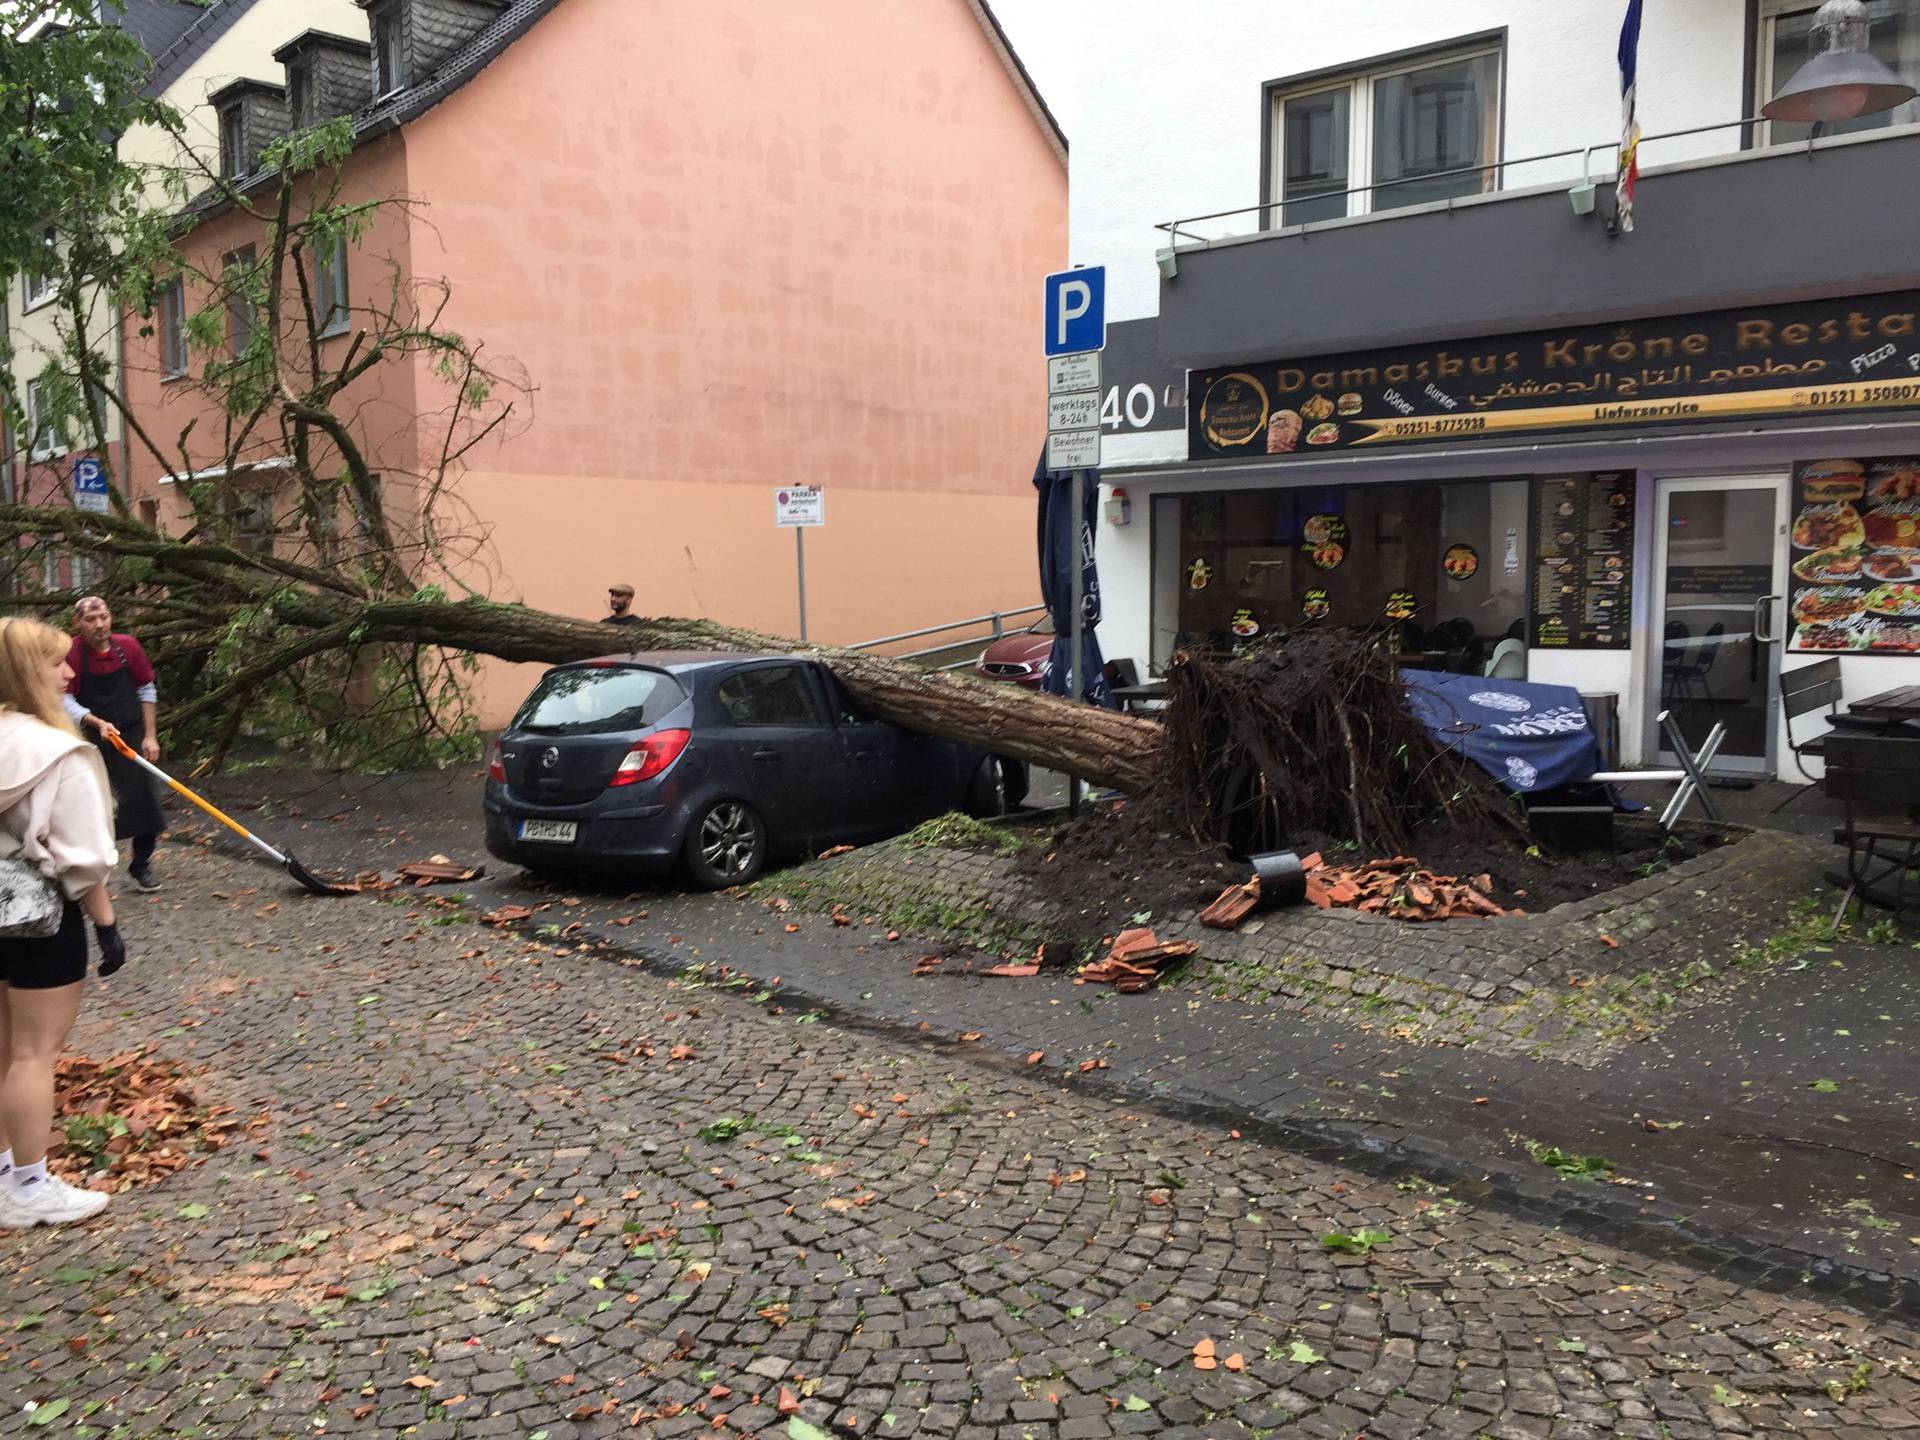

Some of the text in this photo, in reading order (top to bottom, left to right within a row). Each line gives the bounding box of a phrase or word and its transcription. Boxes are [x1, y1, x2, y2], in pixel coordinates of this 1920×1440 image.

[1058, 280, 1091, 345] P
[1850, 342, 1897, 374] Pizza
[1101, 383, 1155, 430] 40
[1383, 387, 1415, 416] Döner
[1424, 382, 1458, 411] Burger
[1594, 402, 1700, 420] Lieferservice
[1811, 389, 1856, 405] 01521
